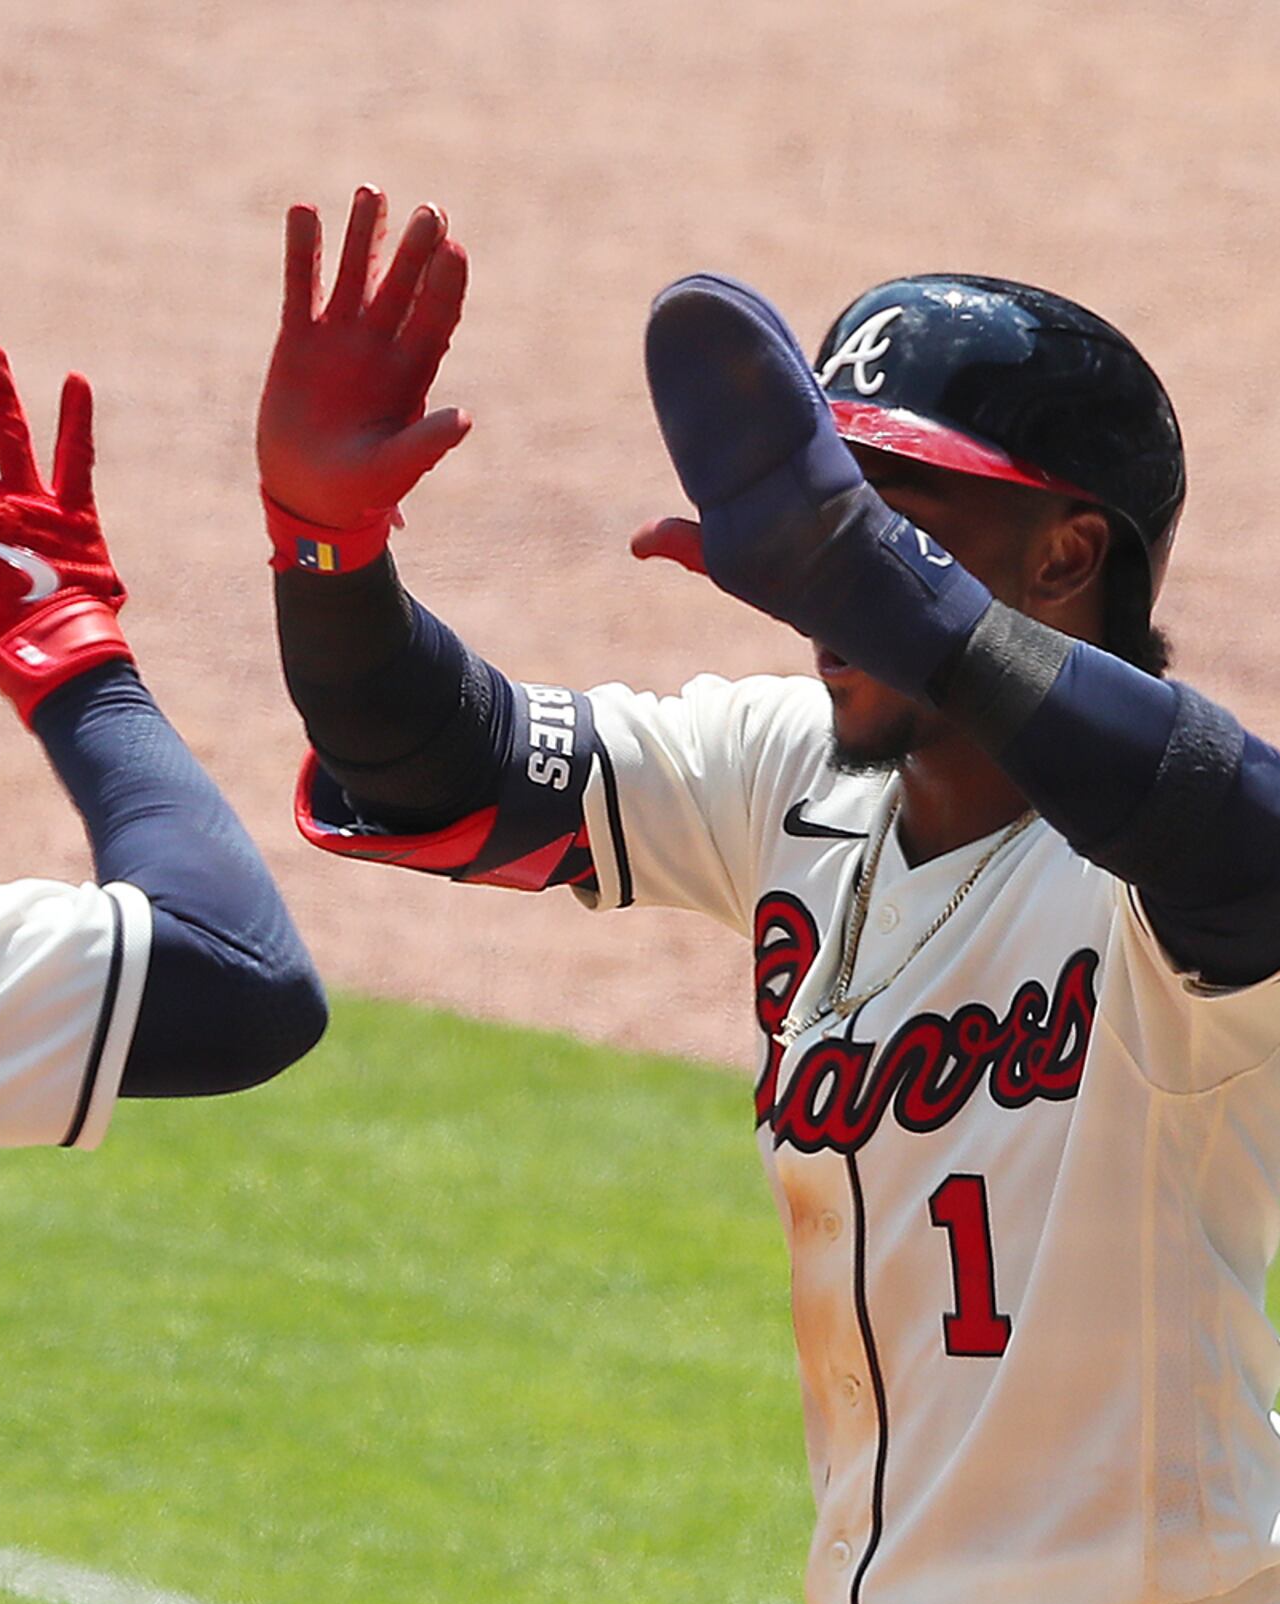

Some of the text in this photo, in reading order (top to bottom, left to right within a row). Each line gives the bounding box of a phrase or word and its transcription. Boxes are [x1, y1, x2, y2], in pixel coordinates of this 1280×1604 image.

[812, 304, 904, 396] A
[520, 682, 577, 791] BIES
[754, 890, 1101, 1154] aves
[928, 1173, 1013, 1357] 1
